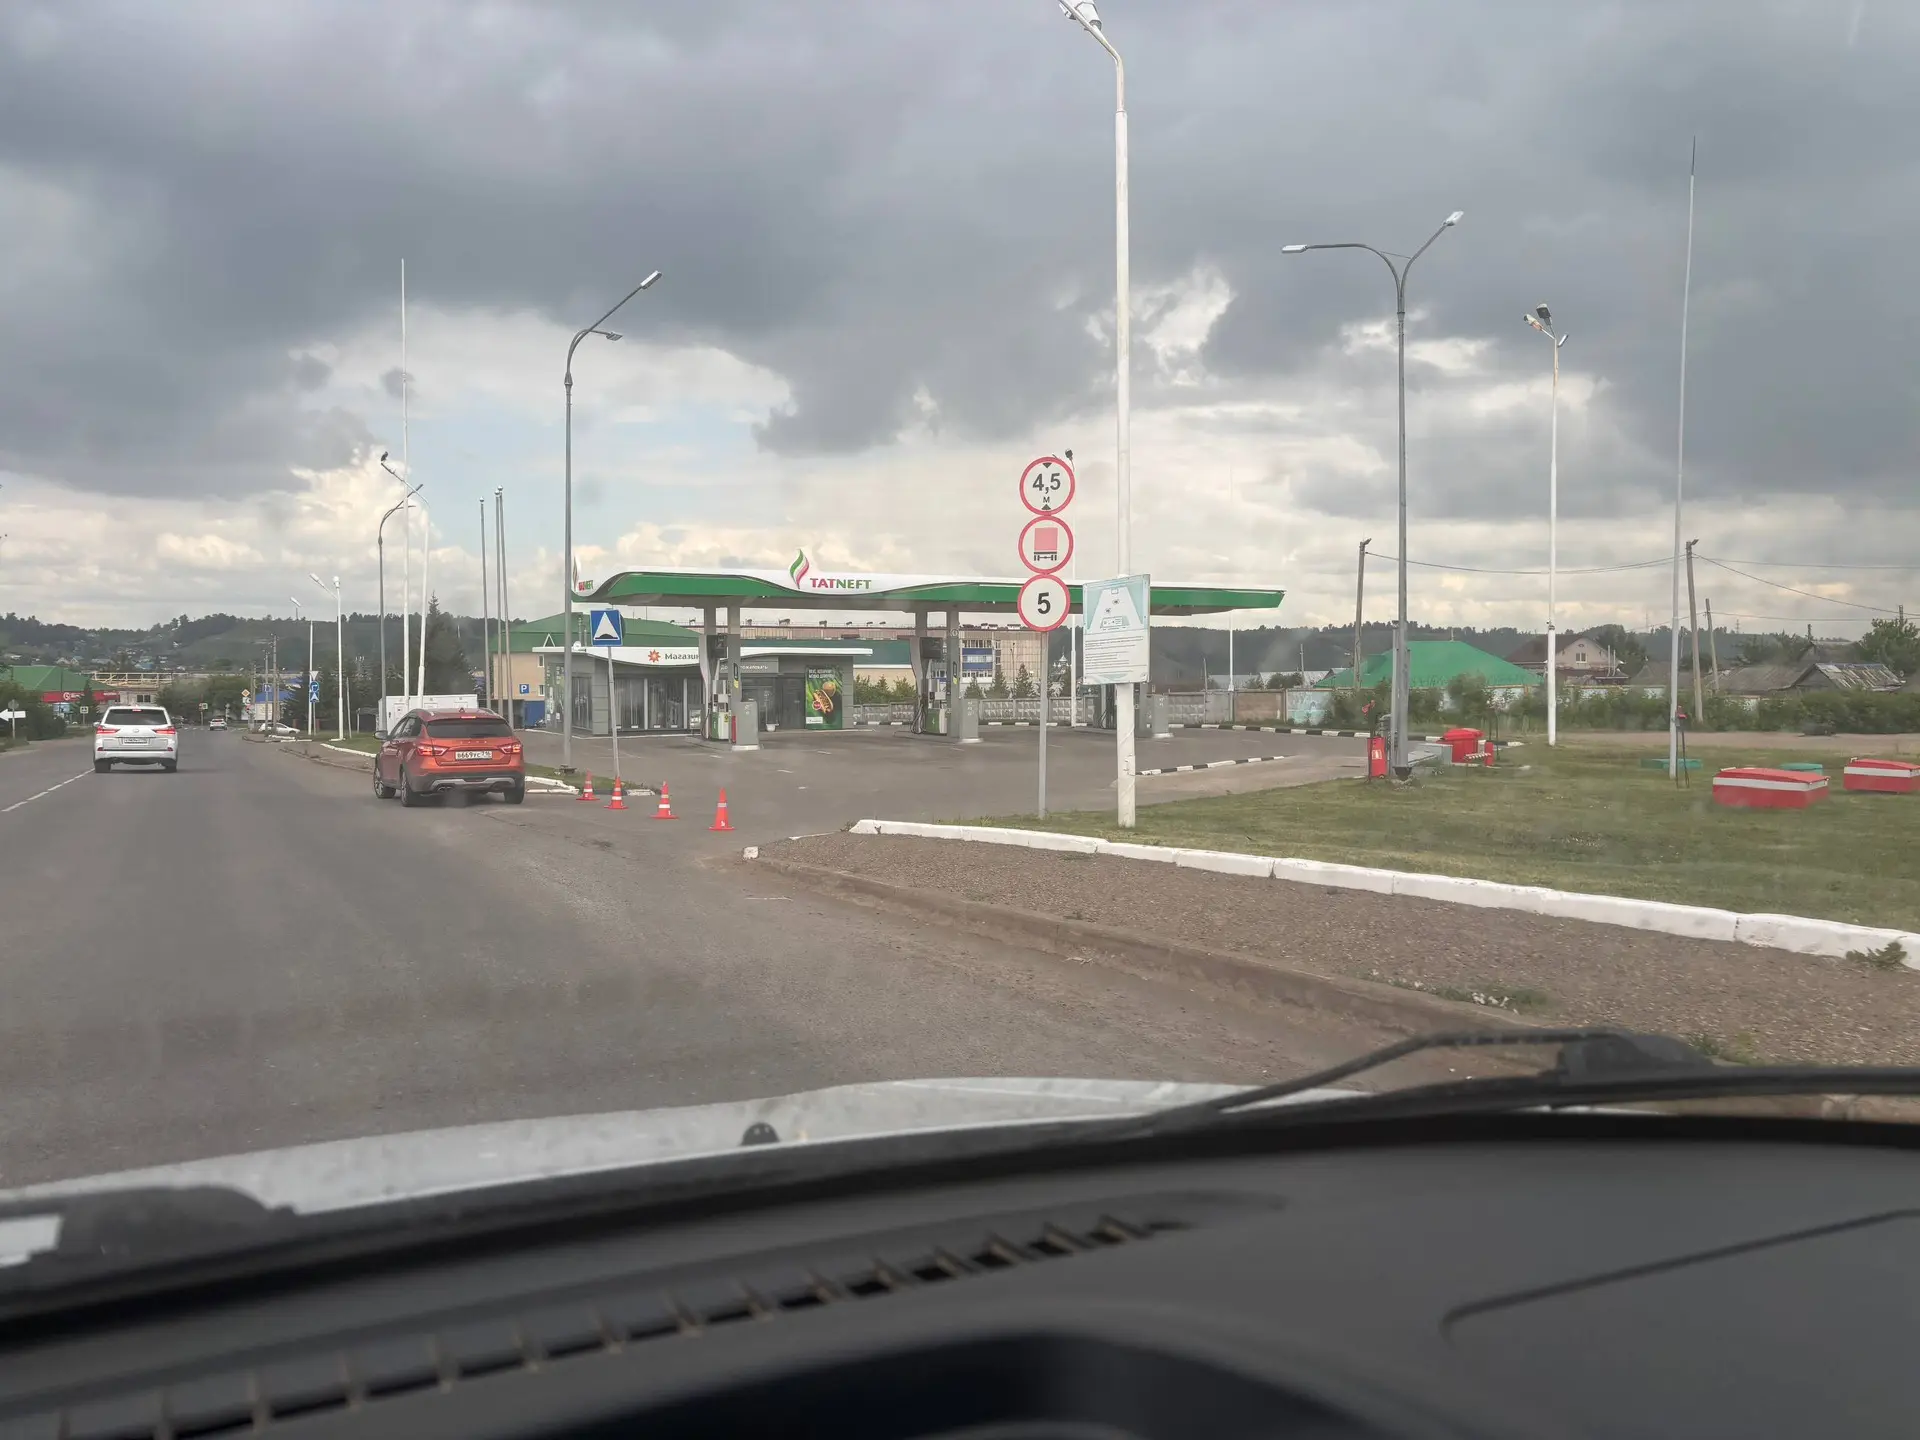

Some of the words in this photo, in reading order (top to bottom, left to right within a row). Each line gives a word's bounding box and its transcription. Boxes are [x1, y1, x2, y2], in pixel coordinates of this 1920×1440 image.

[1033, 472, 1060, 494] 4,5
[810, 578, 872, 589] TATNEFT
[1037, 592, 1051, 614] 5
